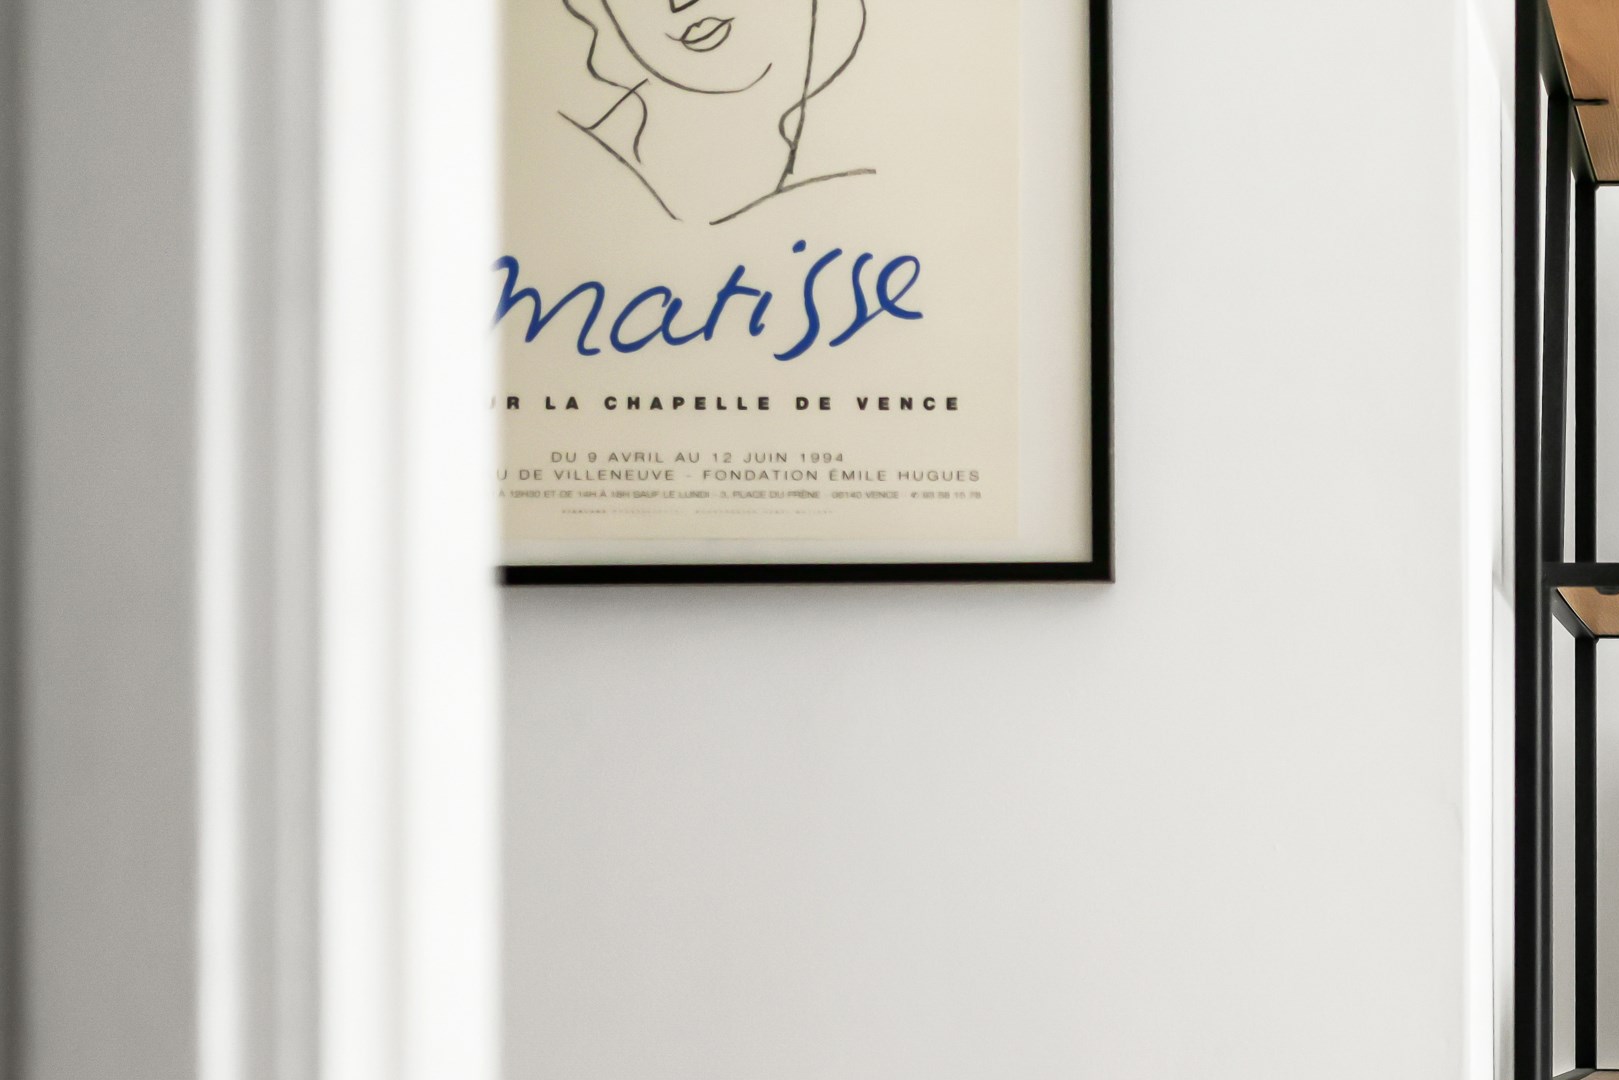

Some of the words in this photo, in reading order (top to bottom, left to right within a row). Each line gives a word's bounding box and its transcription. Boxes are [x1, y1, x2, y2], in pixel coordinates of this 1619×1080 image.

[545, 396, 579, 411] LA
[603, 396, 770, 411] CHAPELLE
[795, 396, 832, 411] DE
[856, 396, 959, 412] VENCE
[551, 451, 577, 464] DU
[587, 451, 598, 464] 9
[608, 451, 665, 464] AVRIL
[674, 451, 700, 464] AU
[712, 451, 733, 464] 12
[743, 452, 788, 464] JUIN
[800, 452, 844, 464] 1994
[518, 469, 543, 481] DE
[553, 469, 675, 482] VILLENEUVE
[702, 469, 818, 482] FONDATION
[897, 469, 981, 482] HUGUES
